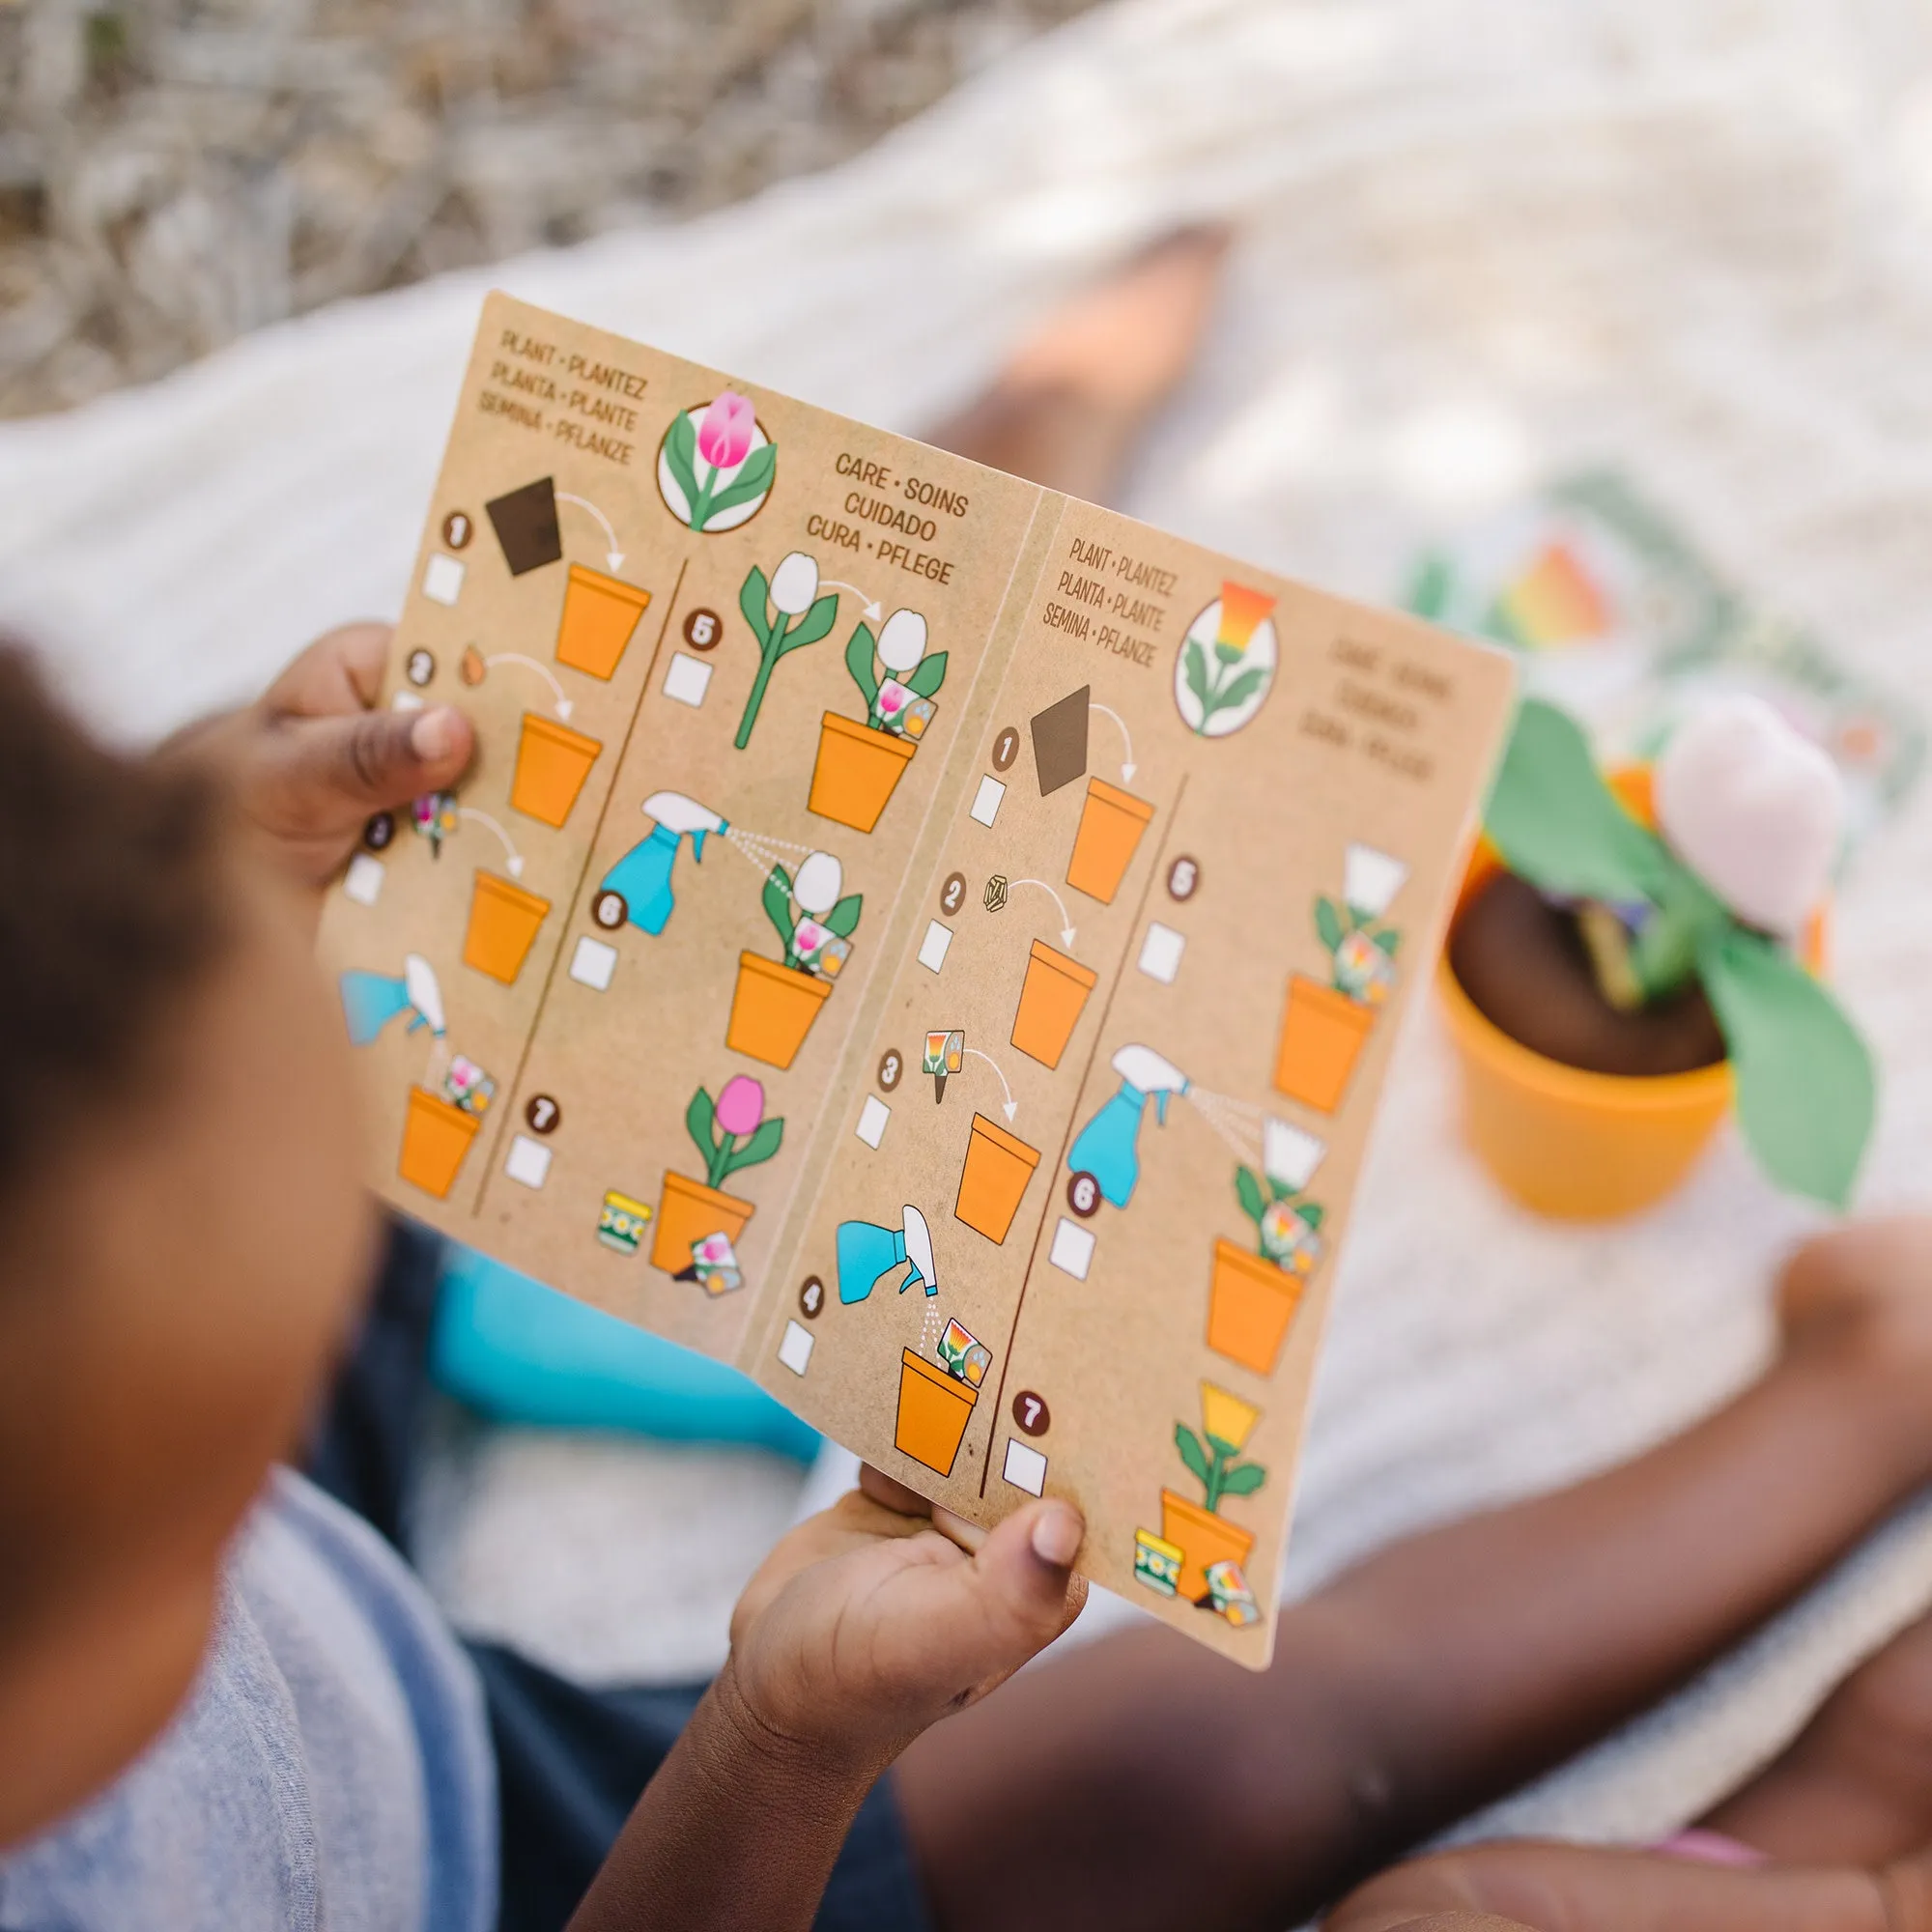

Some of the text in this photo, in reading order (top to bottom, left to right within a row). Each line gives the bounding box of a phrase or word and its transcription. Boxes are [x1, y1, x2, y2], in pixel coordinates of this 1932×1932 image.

[567, 354, 648, 401] PLANTEZ
[568, 390, 639, 433] PLANTE
[836, 453, 969, 518] CARE SOINS
[844, 492, 936, 542] CUIDADO
[807, 515, 954, 585] CURA PFLEGE
[1069, 538, 1179, 597] PLANT PLANTEZ
[1057, 570, 1166, 632] PLANTA PLANTE
[691, 613, 716, 645] 5
[1042, 602, 1157, 668] SEMINA PFLANZE
[1000, 736, 1014, 763] 1
[944, 880, 962, 909] 2
[881, 1056, 899, 1084] 3
[533, 1097, 555, 1129] 7
[1073, 1178, 1095, 1211] 6
[803, 1284, 821, 1311] 4
[1024, 1398, 1041, 1428] 7
